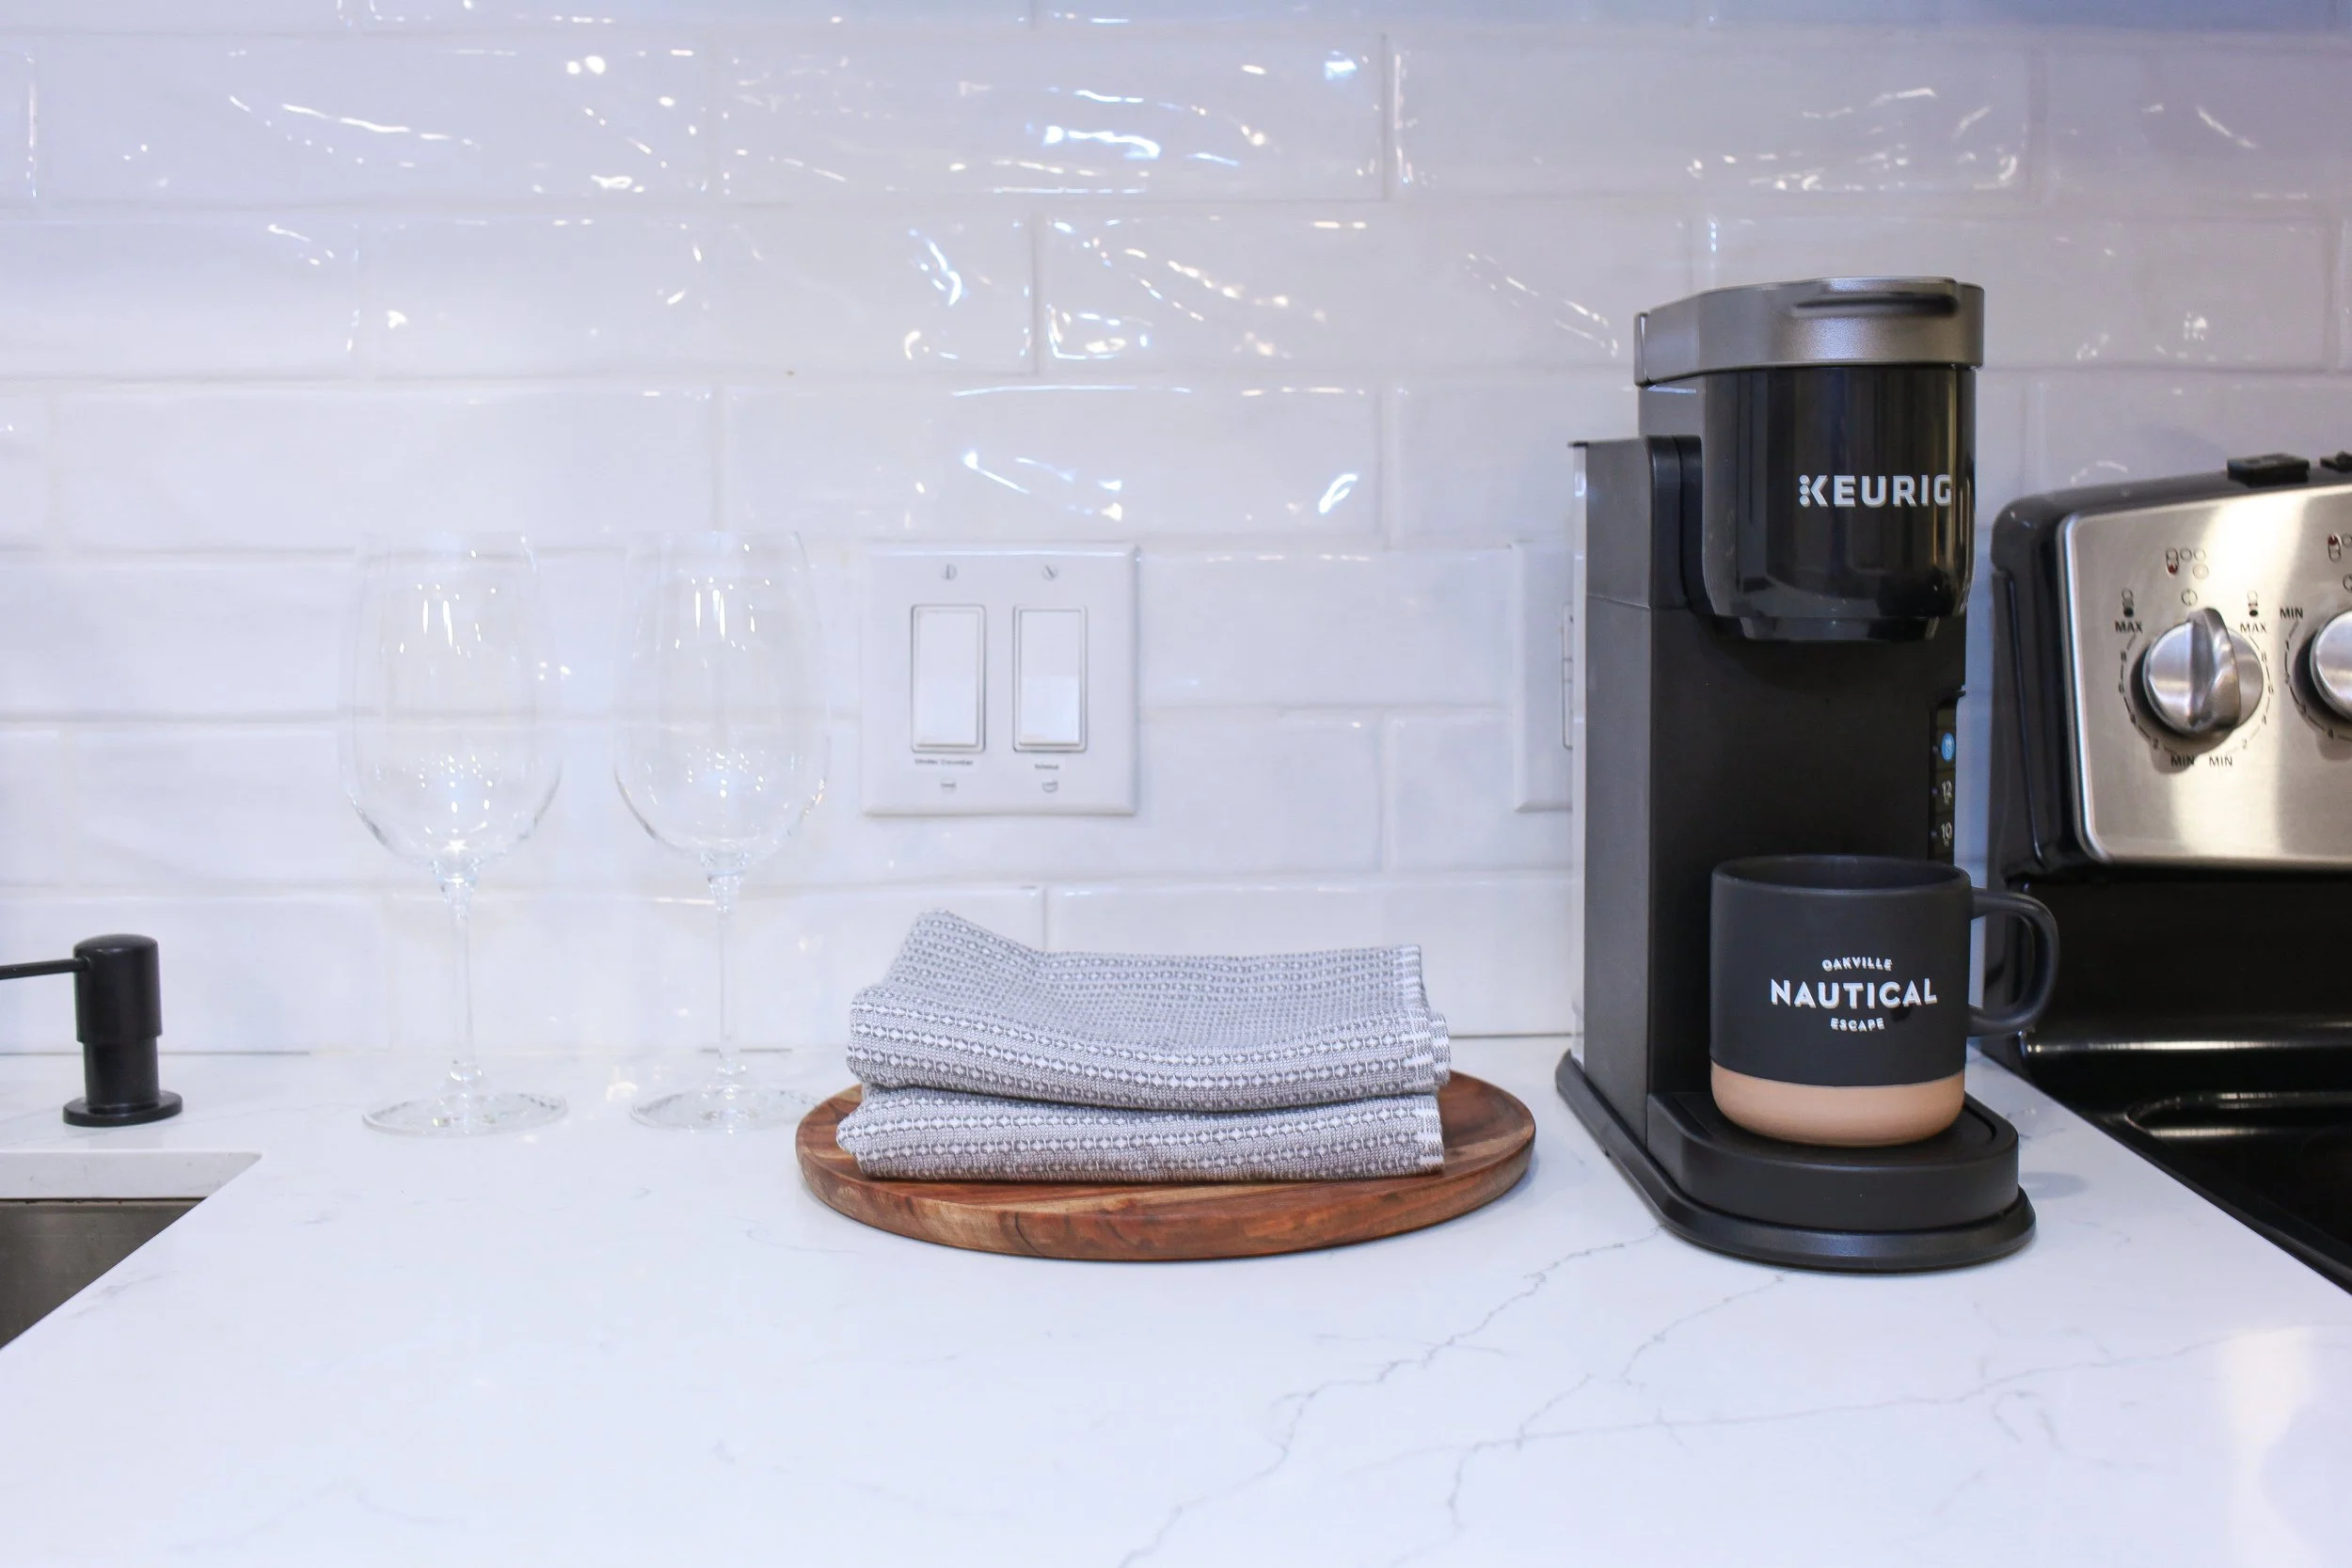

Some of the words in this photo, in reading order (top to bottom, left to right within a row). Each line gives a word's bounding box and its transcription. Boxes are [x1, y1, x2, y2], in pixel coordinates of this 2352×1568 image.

[1799, 474, 1952, 508] KEURIG
[2280, 607, 2303, 619] MIN
[2115, 621, 2142, 633] MAX
[2240, 622, 2267, 633] MAX
[2170, 755, 2195, 767] MIN
[2209, 756, 2233, 767] MIN
[1941, 780, 1952, 799] 12
[1941, 822, 1953, 840] 10
[1821, 956, 1893, 971] OAKVILLE
[1771, 977, 1938, 1010] NAUTICAL
[1830, 1017, 1885, 1032] ESCAPE
